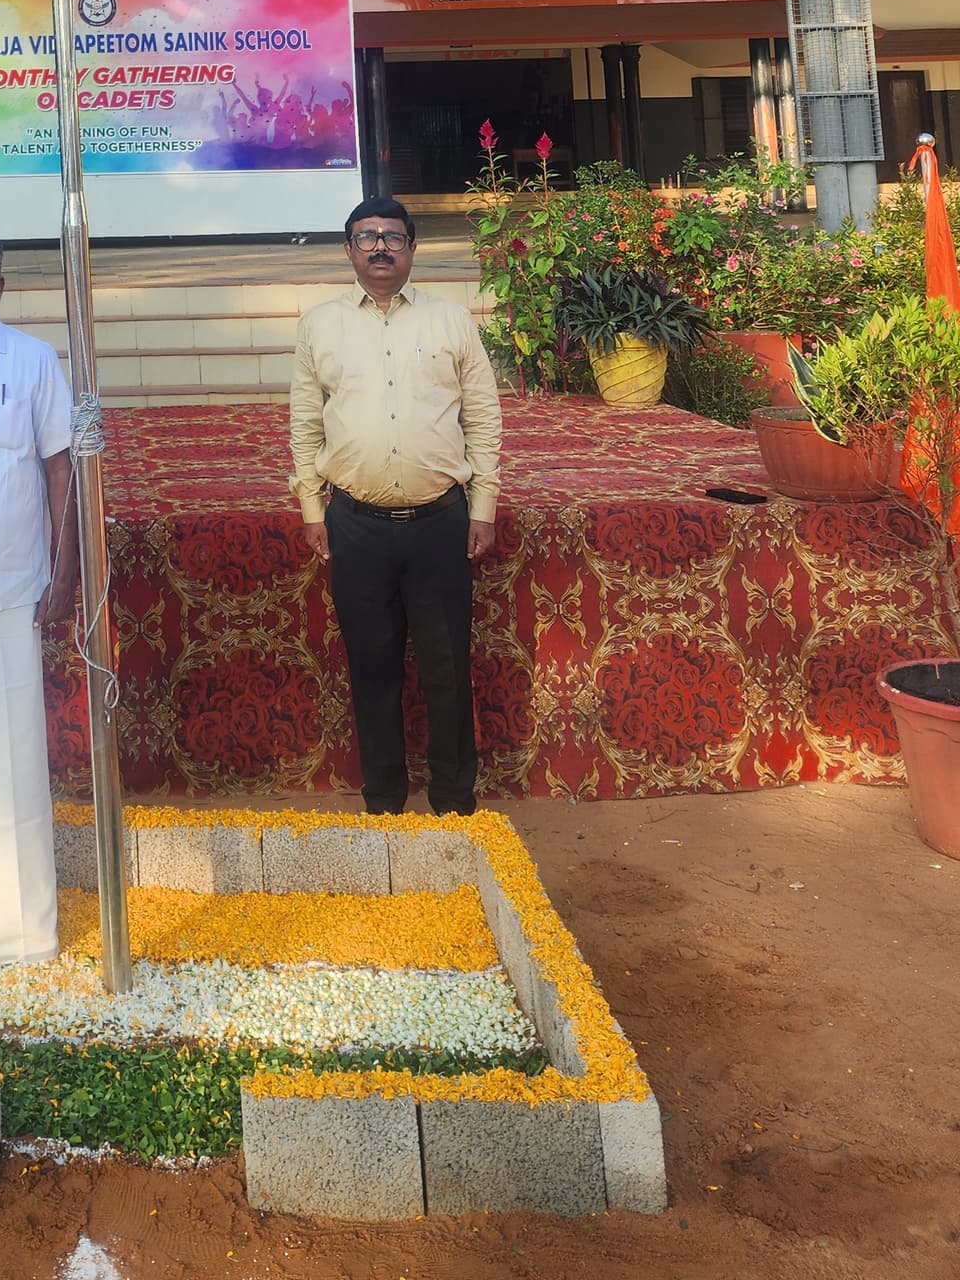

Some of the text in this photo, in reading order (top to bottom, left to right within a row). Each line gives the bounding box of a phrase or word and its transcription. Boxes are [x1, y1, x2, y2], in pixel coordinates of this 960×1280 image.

[29, 32, 157, 56] VIDAPEETOM
[164, 30, 228, 52] SAINIK
[235, 28, 312, 51] SCHOOL
[93, 64, 236, 86] GATHERING
[37, 89, 175, 110] O CADETS
[119, 126, 137, 138] OF
[142, 125, 172, 139] FUN,
[2, 143, 53, 155] TALENT
